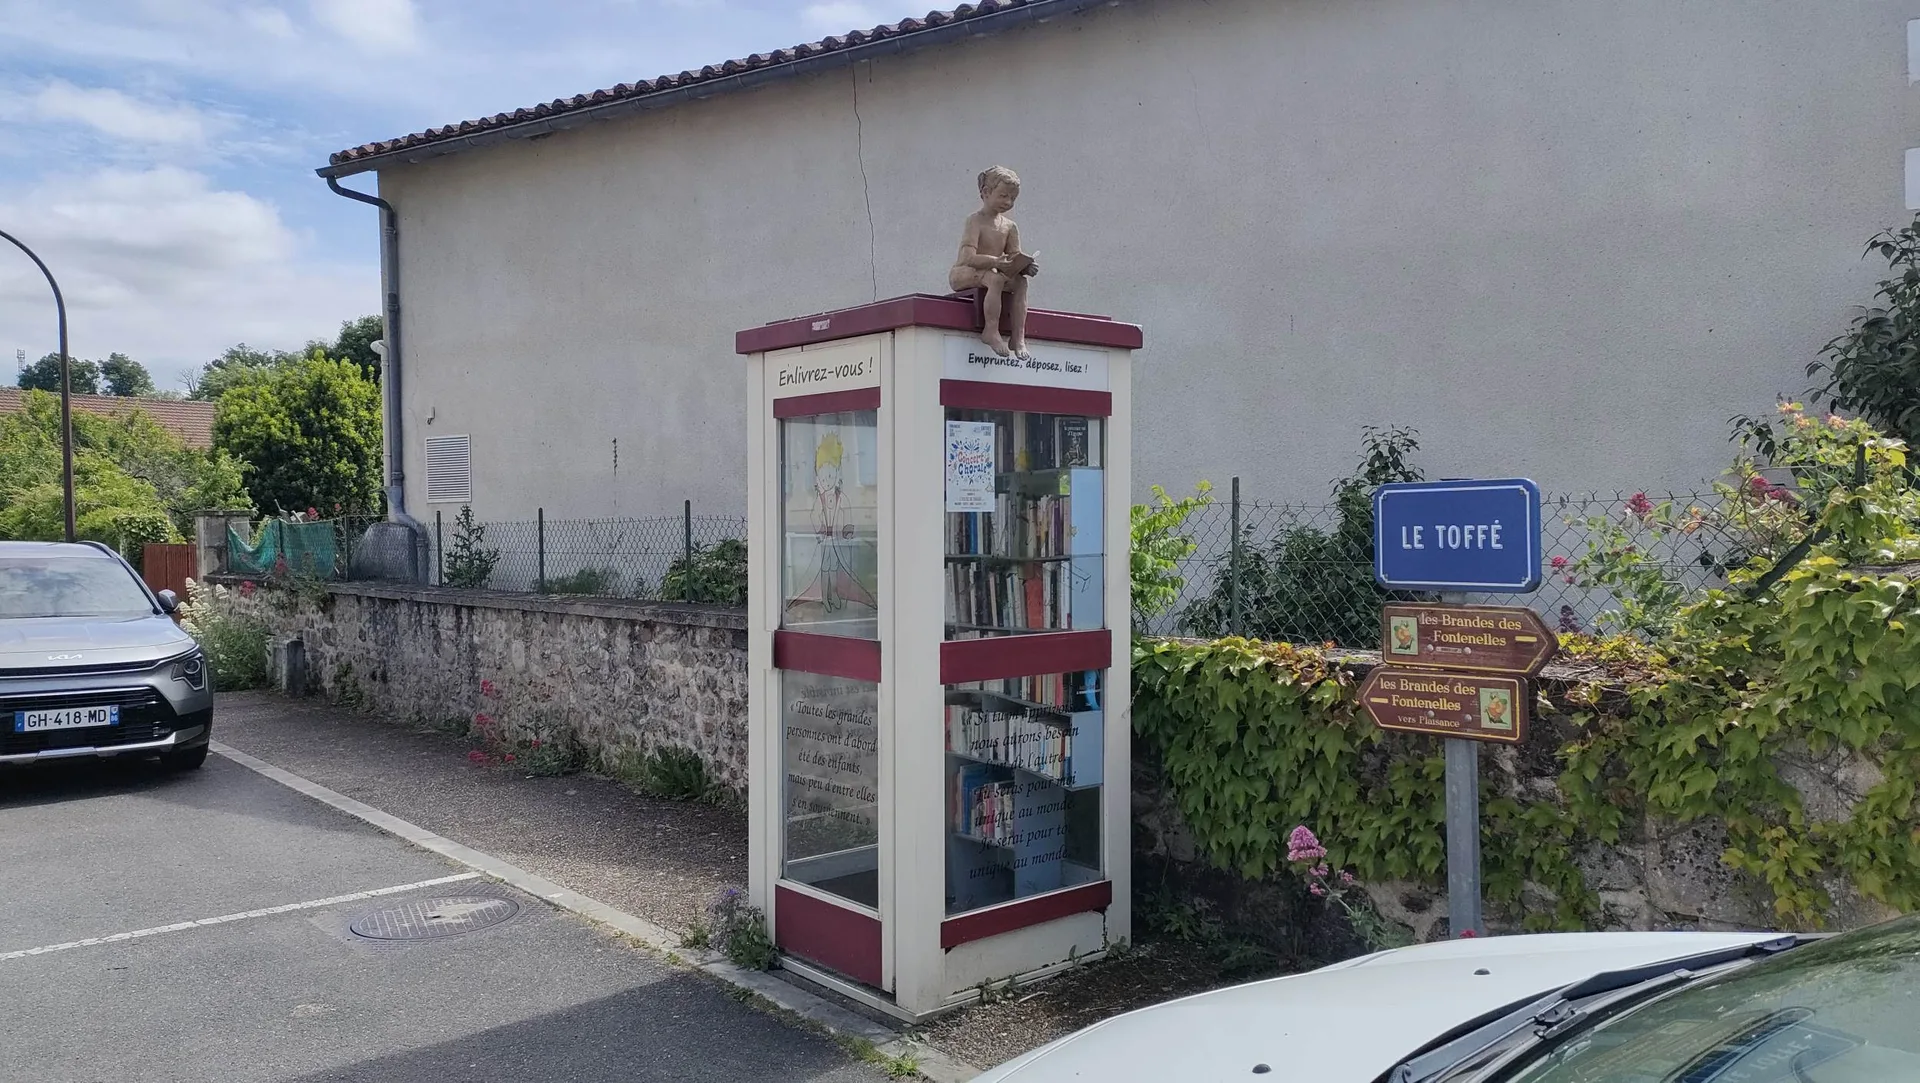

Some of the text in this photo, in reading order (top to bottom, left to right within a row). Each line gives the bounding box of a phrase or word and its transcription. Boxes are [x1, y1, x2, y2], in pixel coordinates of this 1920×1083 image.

[968, 353, 1023, 368] Empruntez,
[1025, 357, 1063, 373] déposez,
[1065, 361, 1082, 373] lisez
[779, 361, 864, 387] Enlivrez-vous
[1402, 519, 1503, 550] LE TOFFÉ
[1420, 611, 1522, 630] les Brandes des
[1433, 630, 1507, 646] Fontenelles
[1380, 677, 1476, 695] les Brandes des
[1391, 694, 1461, 711] Fontenelles
[27, 709, 107, 729] GH-418-MD
[795, 701, 823, 718] Toutes
[825, 703, 836, 720] les
[837, 709, 872, 727] grandes
[974, 709, 989, 727] Si
[1397, 714, 1460, 728] vers Plaisance
[786, 724, 826, 741] personnes
[827, 733, 842, 746] ont
[970, 723, 1080, 751] nous aurons besoin
[798, 748, 810, 763] été
[812, 749, 826, 767] des
[828, 755, 863, 777] enfants,
[788, 772, 876, 804] mais peu d'entre elles
[1026, 779, 1054, 798] pour
[1018, 805, 1033, 819] au
[1026, 825, 1055, 848] pour
[1013, 856, 1029, 870] au
